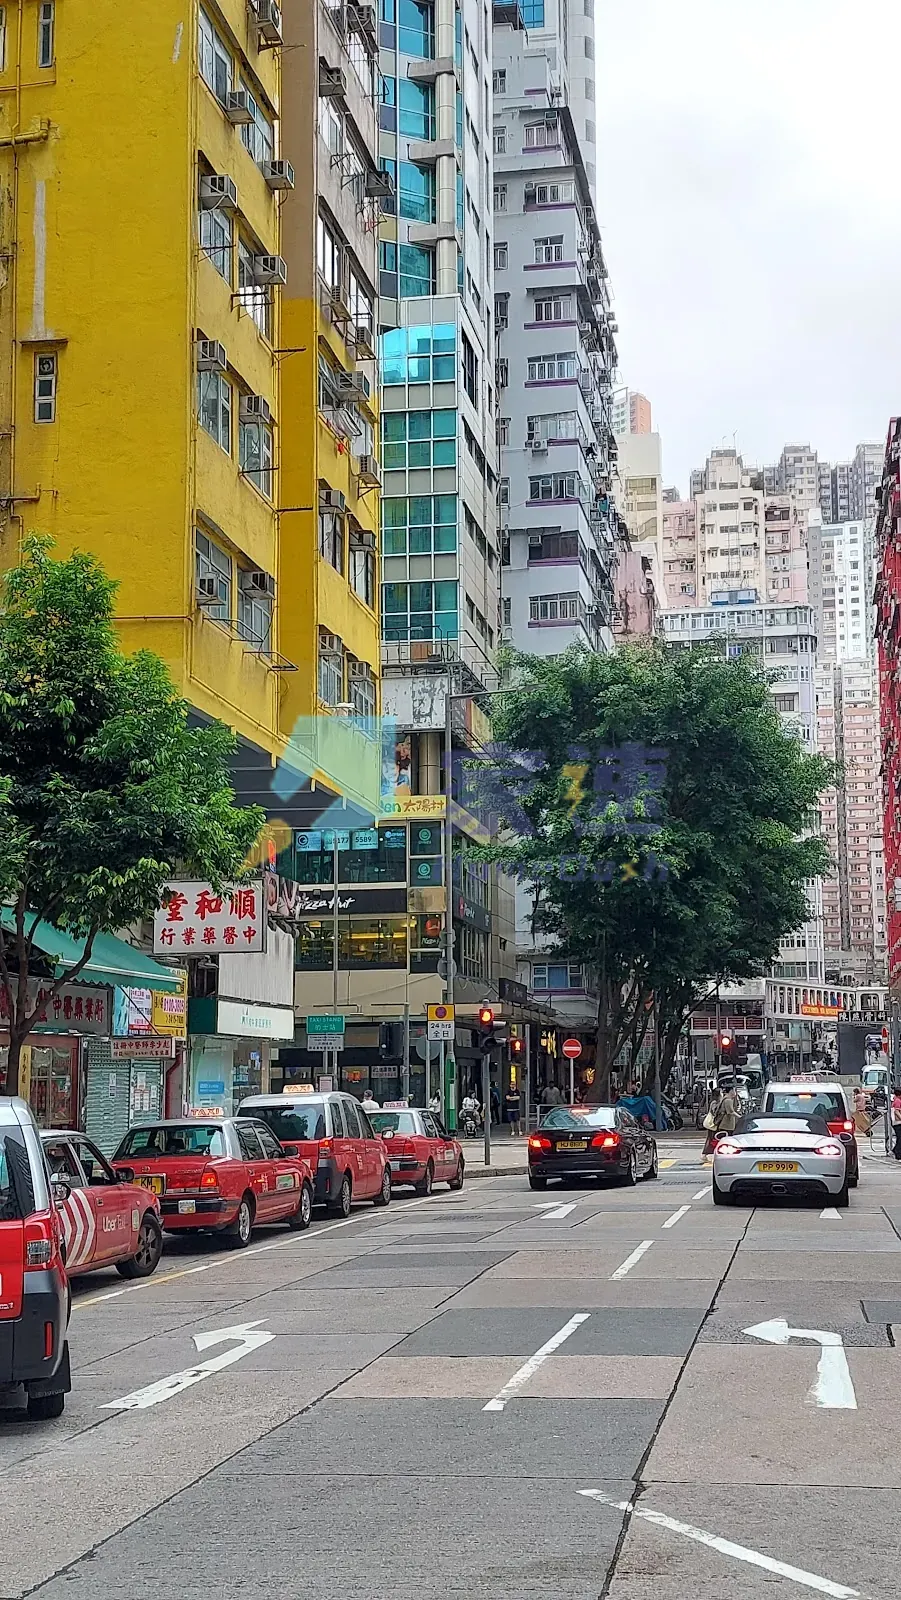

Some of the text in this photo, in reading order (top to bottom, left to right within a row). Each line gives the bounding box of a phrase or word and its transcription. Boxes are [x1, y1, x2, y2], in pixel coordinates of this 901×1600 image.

[403, 799, 445, 813] 太陽村
[432, 1030, 449, 1038] 全日
[190, 1107, 220, 1116] TAXI
[762, 1163, 794, 1171] PP 9919
